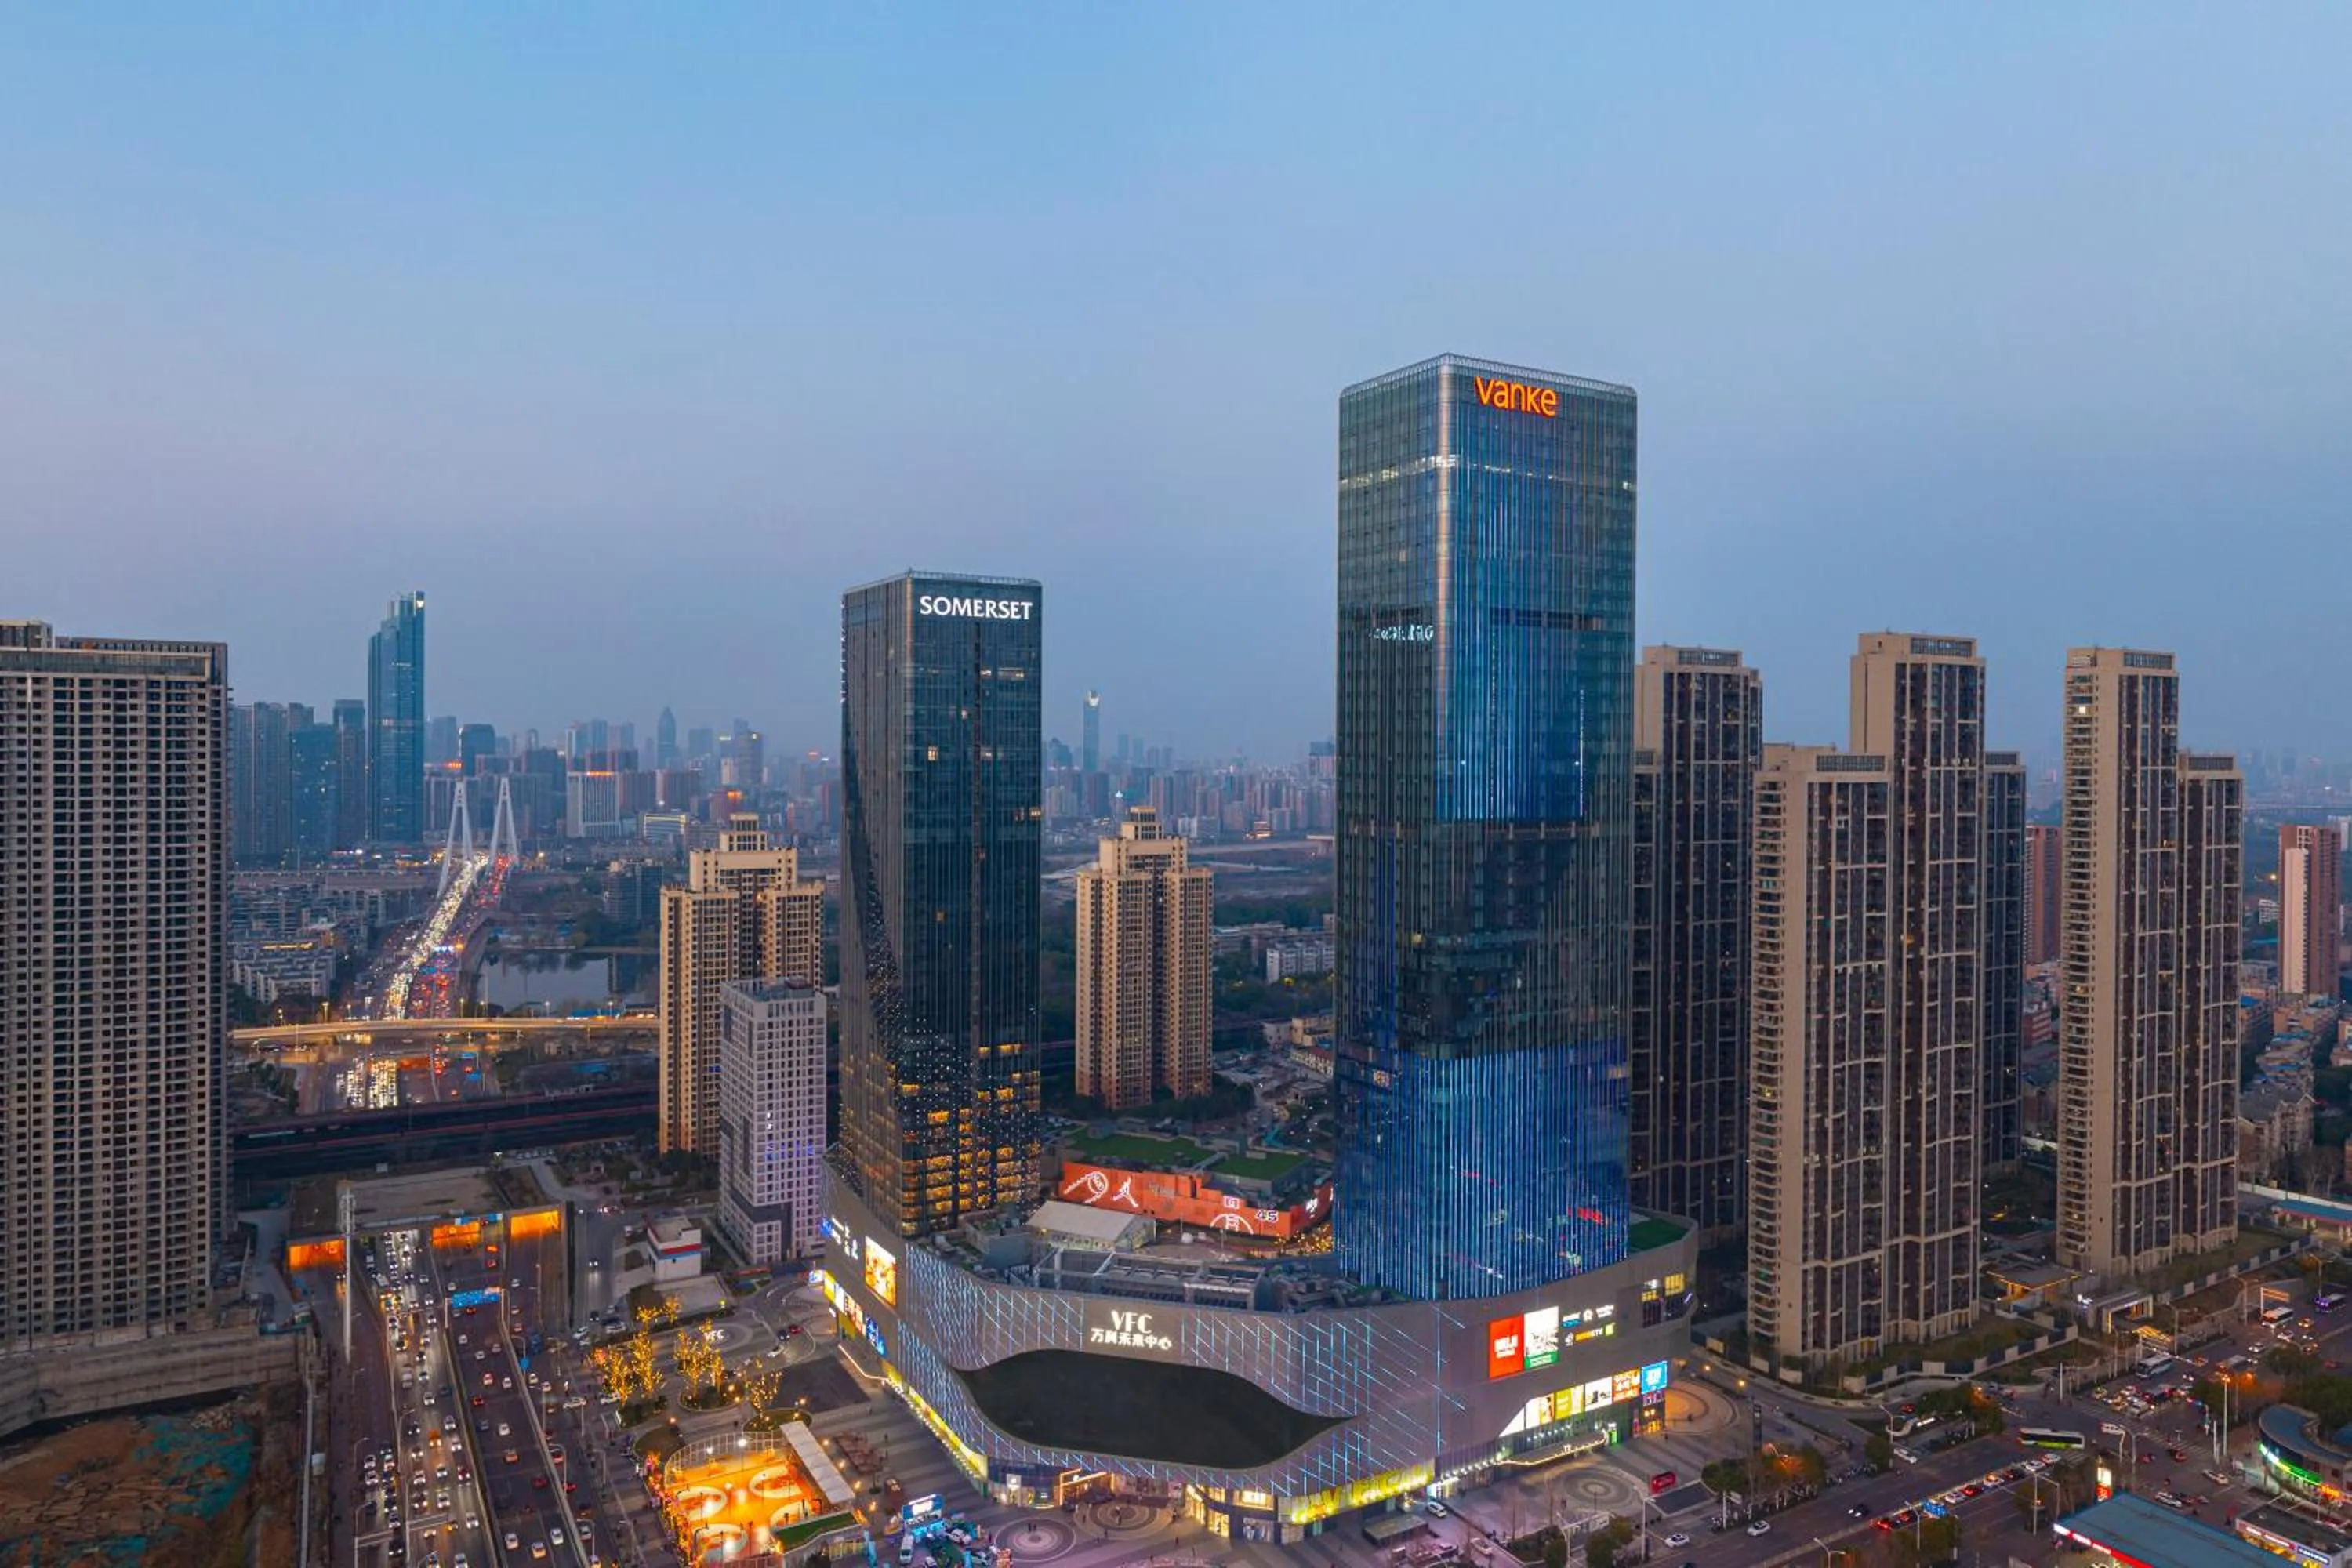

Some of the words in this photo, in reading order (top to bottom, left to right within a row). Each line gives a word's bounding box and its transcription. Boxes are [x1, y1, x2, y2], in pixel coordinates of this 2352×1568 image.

[1475, 376, 1556, 416] vanke
[920, 596, 1033, 620] SOMERSET
[1111, 1310, 1152, 1334] VFC
